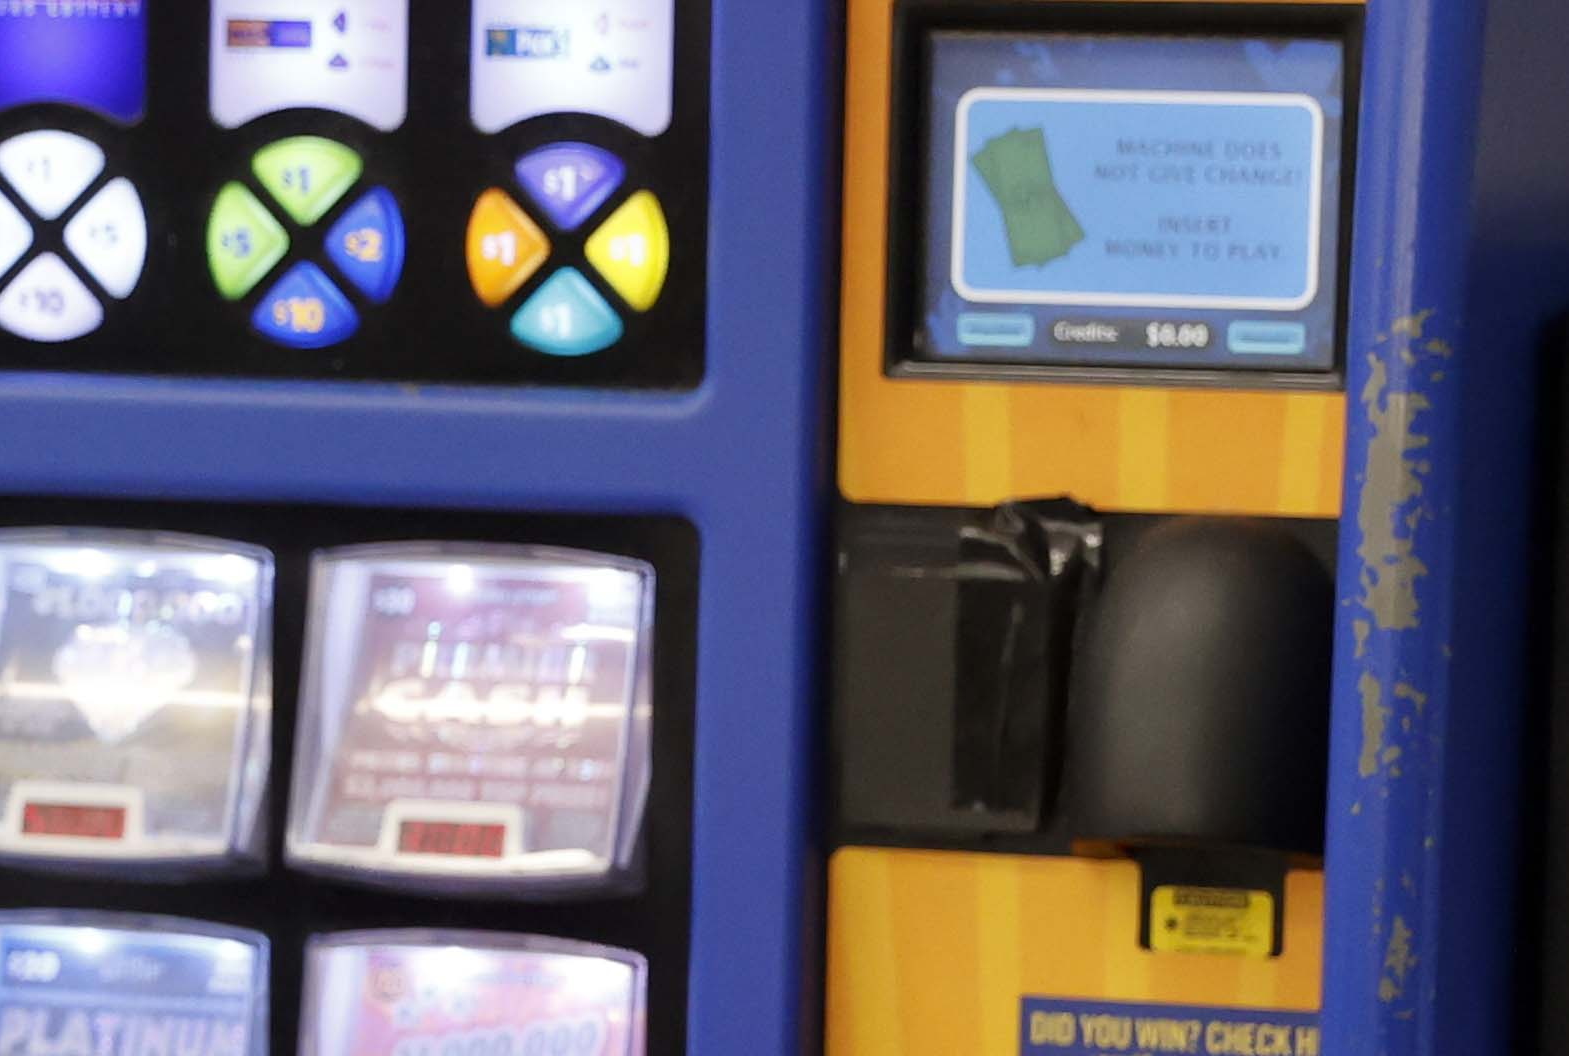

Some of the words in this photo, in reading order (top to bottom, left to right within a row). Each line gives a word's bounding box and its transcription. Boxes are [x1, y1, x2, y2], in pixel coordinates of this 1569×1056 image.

[542, 165, 578, 201] $1
[481, 231, 517, 267] $1
[608, 231, 646, 267] $1
[272, 297, 326, 333] $10
[538, 303, 573, 339] $1
[1080, 1013, 1131, 1050] YOU
[1135, 1017, 1202, 1053] WIN?
